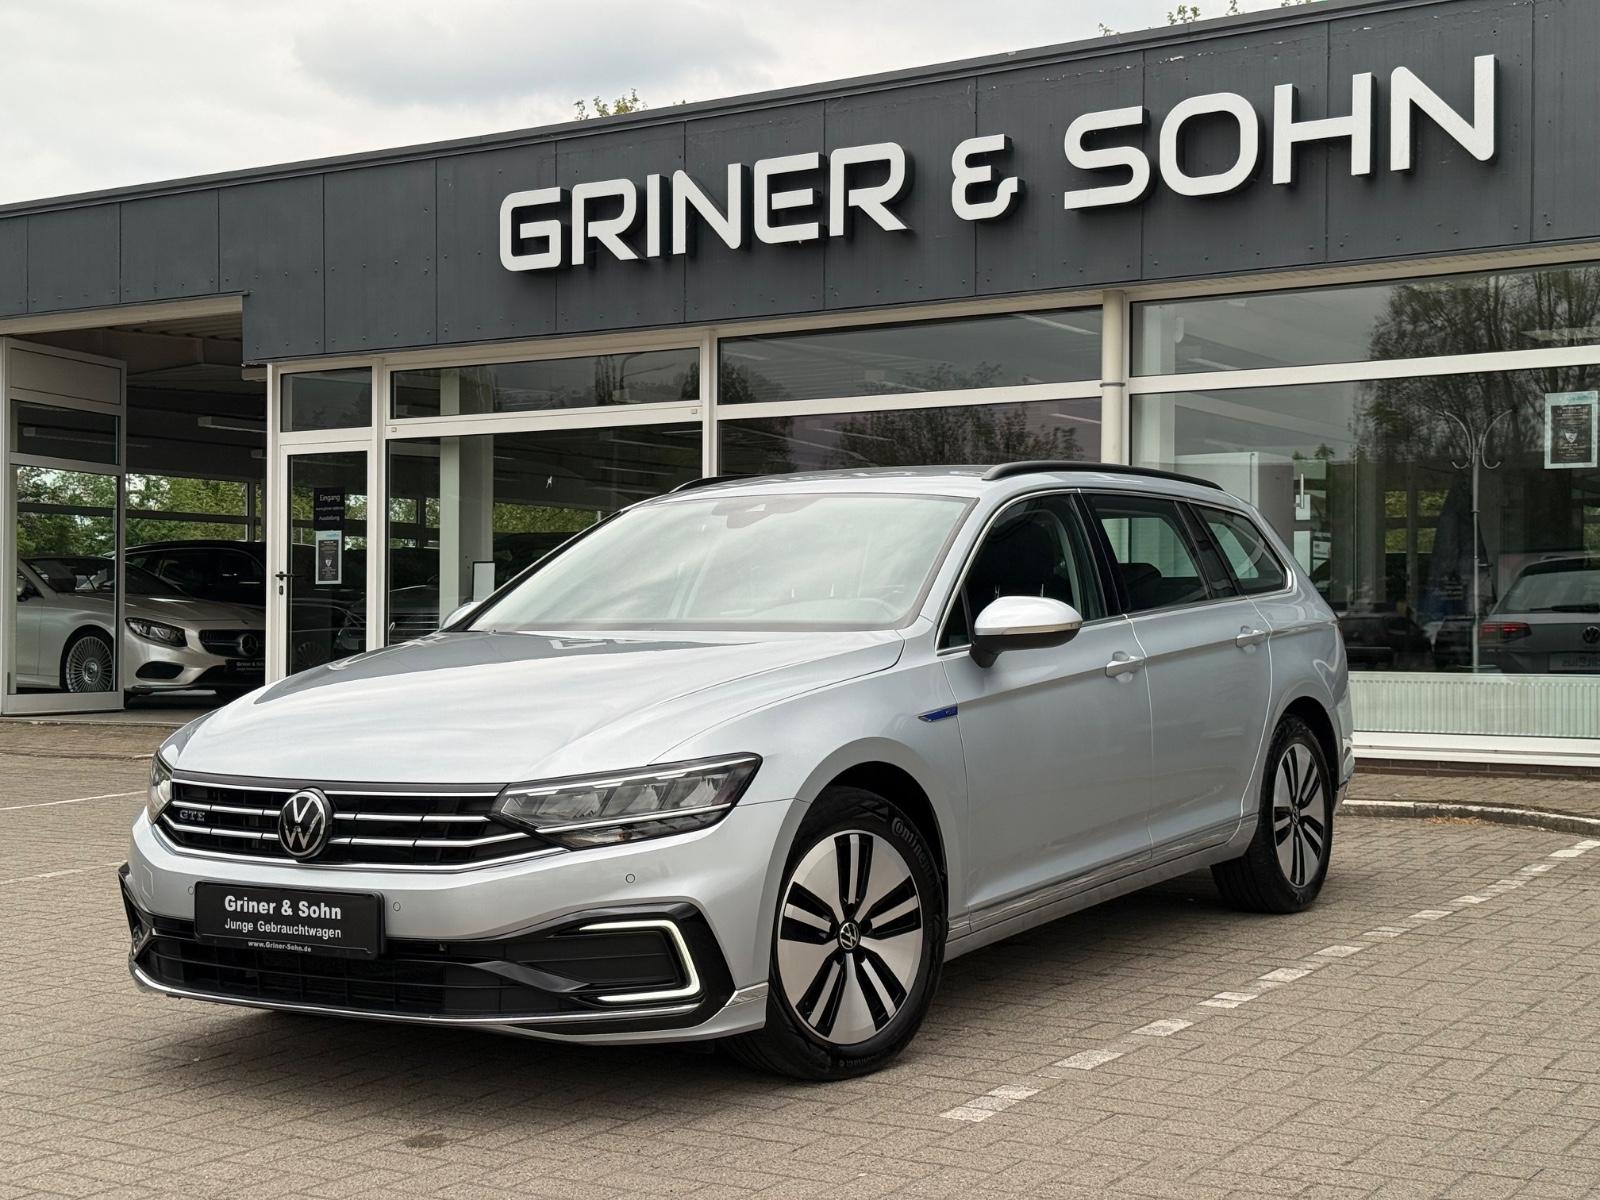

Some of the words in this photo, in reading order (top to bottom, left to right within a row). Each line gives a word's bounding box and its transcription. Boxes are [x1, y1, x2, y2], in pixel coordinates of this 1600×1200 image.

[499, 141, 910, 273] GRINER
[951, 133, 1019, 222] &
[1063, 53, 1497, 211] SOHN
[179, 809, 206, 822] GTE
[224, 895, 276, 915] Griner
[281, 899, 293, 916] &
[298, 901, 342, 920] Sohn
[224, 918, 254, 933] Junge
[257, 920, 342, 940] Gebrauchtwagen
[247, 940, 312, 953] www.Griner-Sohn.de
